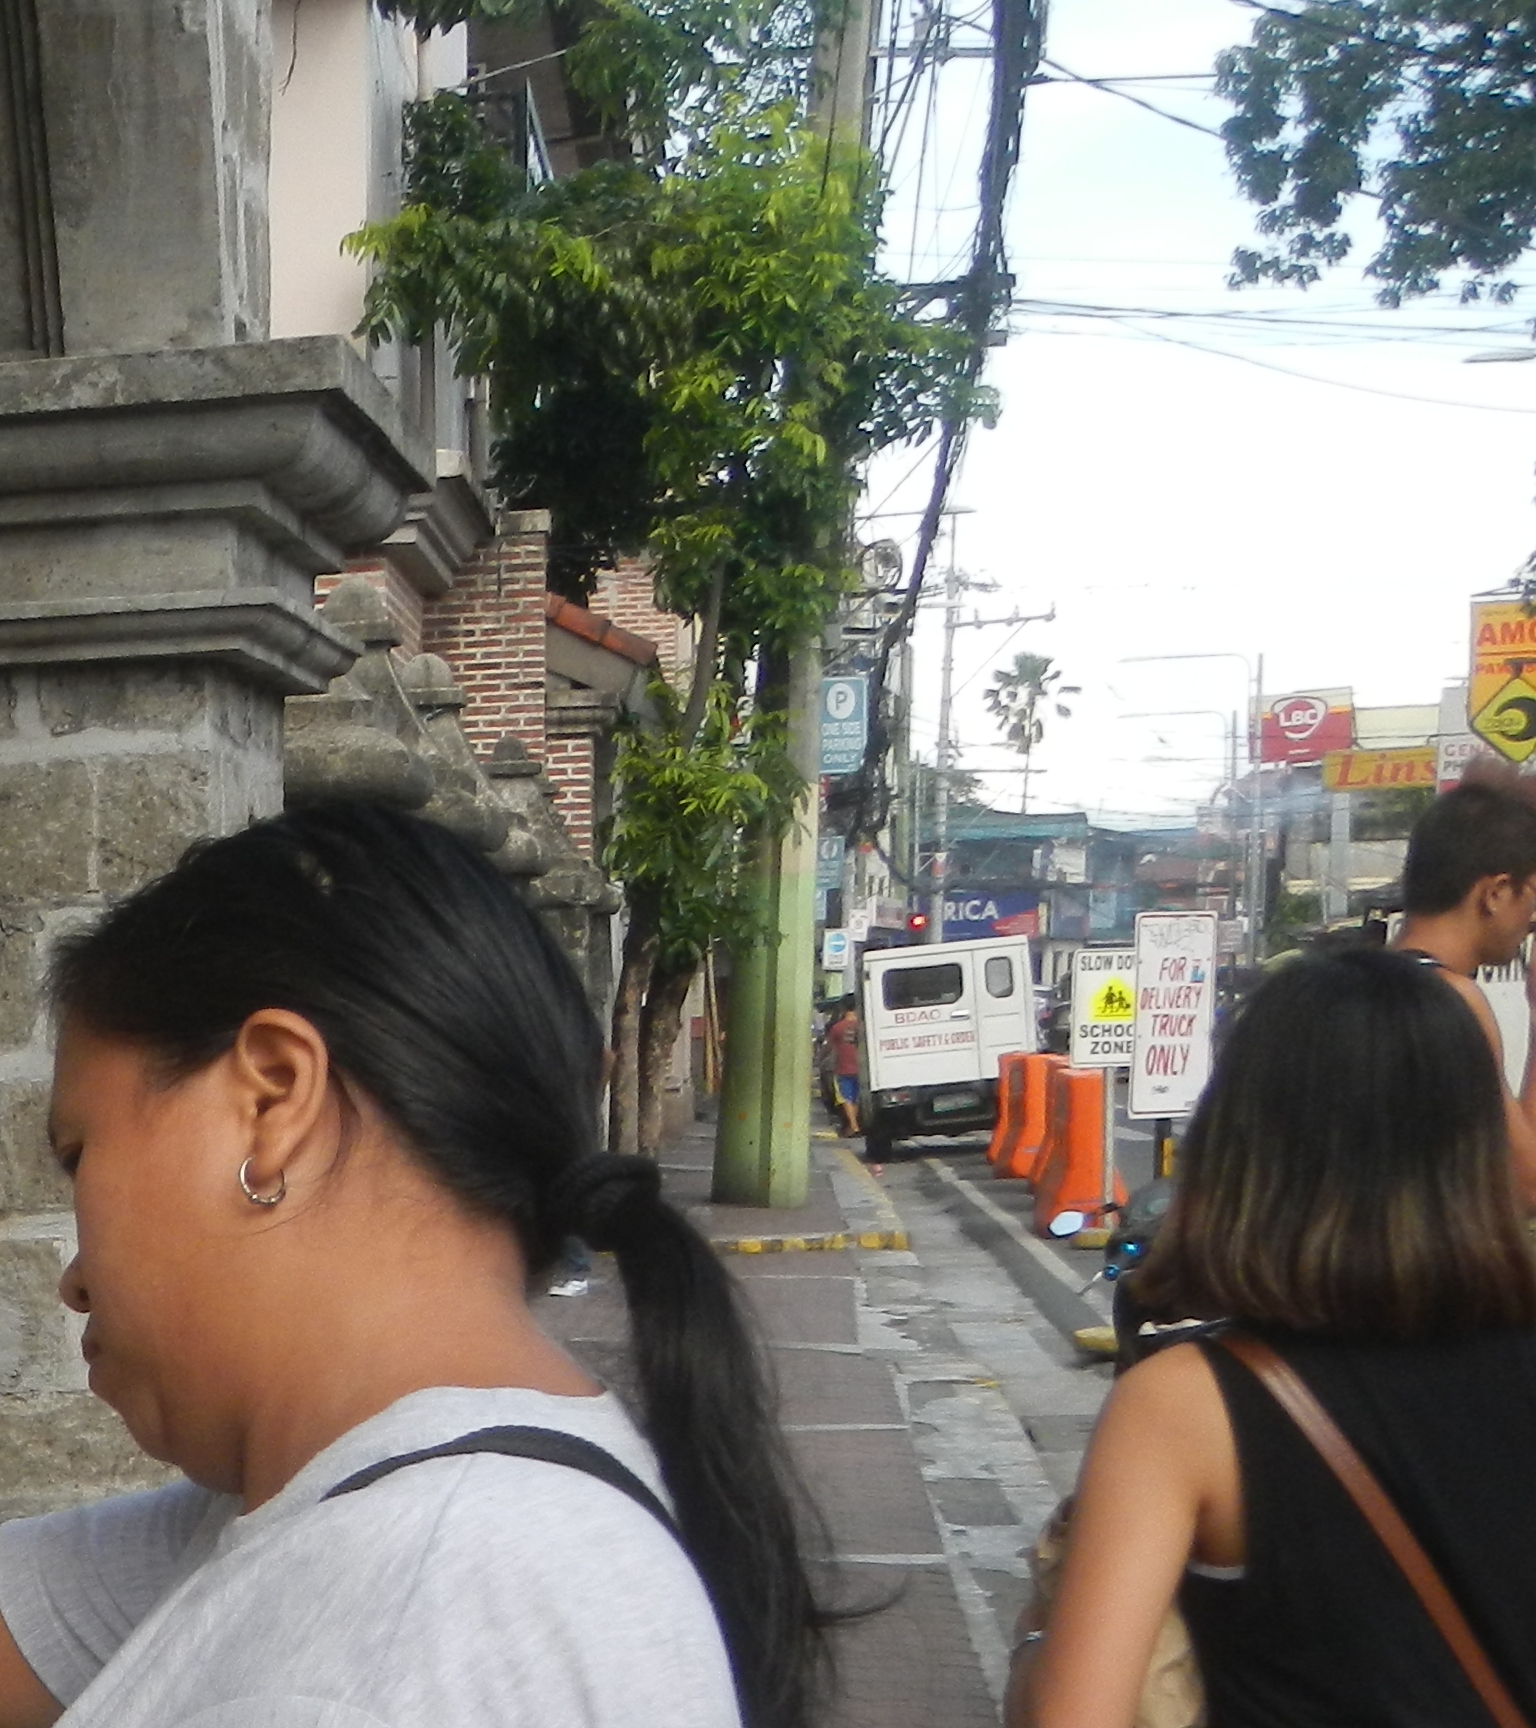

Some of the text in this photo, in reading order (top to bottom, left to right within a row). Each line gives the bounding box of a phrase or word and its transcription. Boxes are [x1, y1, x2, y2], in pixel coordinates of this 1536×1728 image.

[1279, 708, 1319, 728] LBC
[1080, 955, 1133, 972] SLOW DO
[1159, 957, 1187, 981] FOR
[1140, 985, 1203, 1011] DELIVERY
[1151, 1014, 1197, 1038] TRUCK
[1145, 1044, 1191, 1076] ONLY
